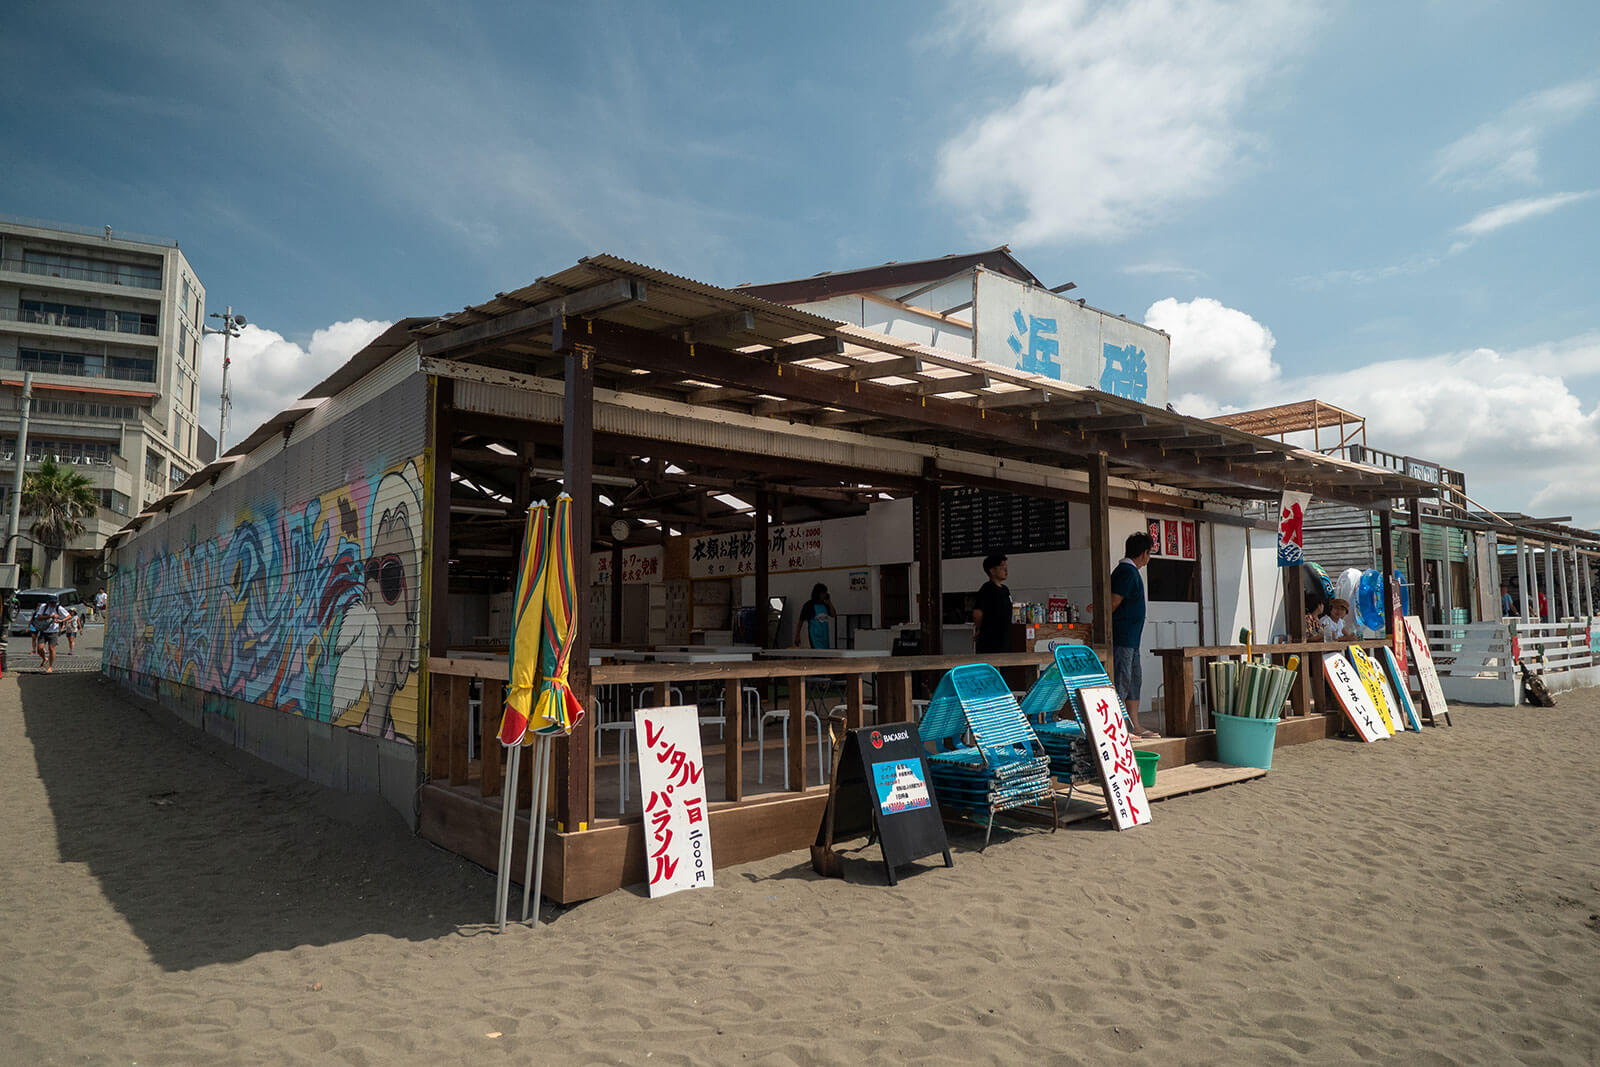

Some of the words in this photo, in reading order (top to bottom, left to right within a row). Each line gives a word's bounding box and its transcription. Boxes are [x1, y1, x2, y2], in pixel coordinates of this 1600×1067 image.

[644, 719, 704, 789] レンタル
[1114, 711, 1142, 786] レンタル
[645, 784, 680, 886] パラソル
